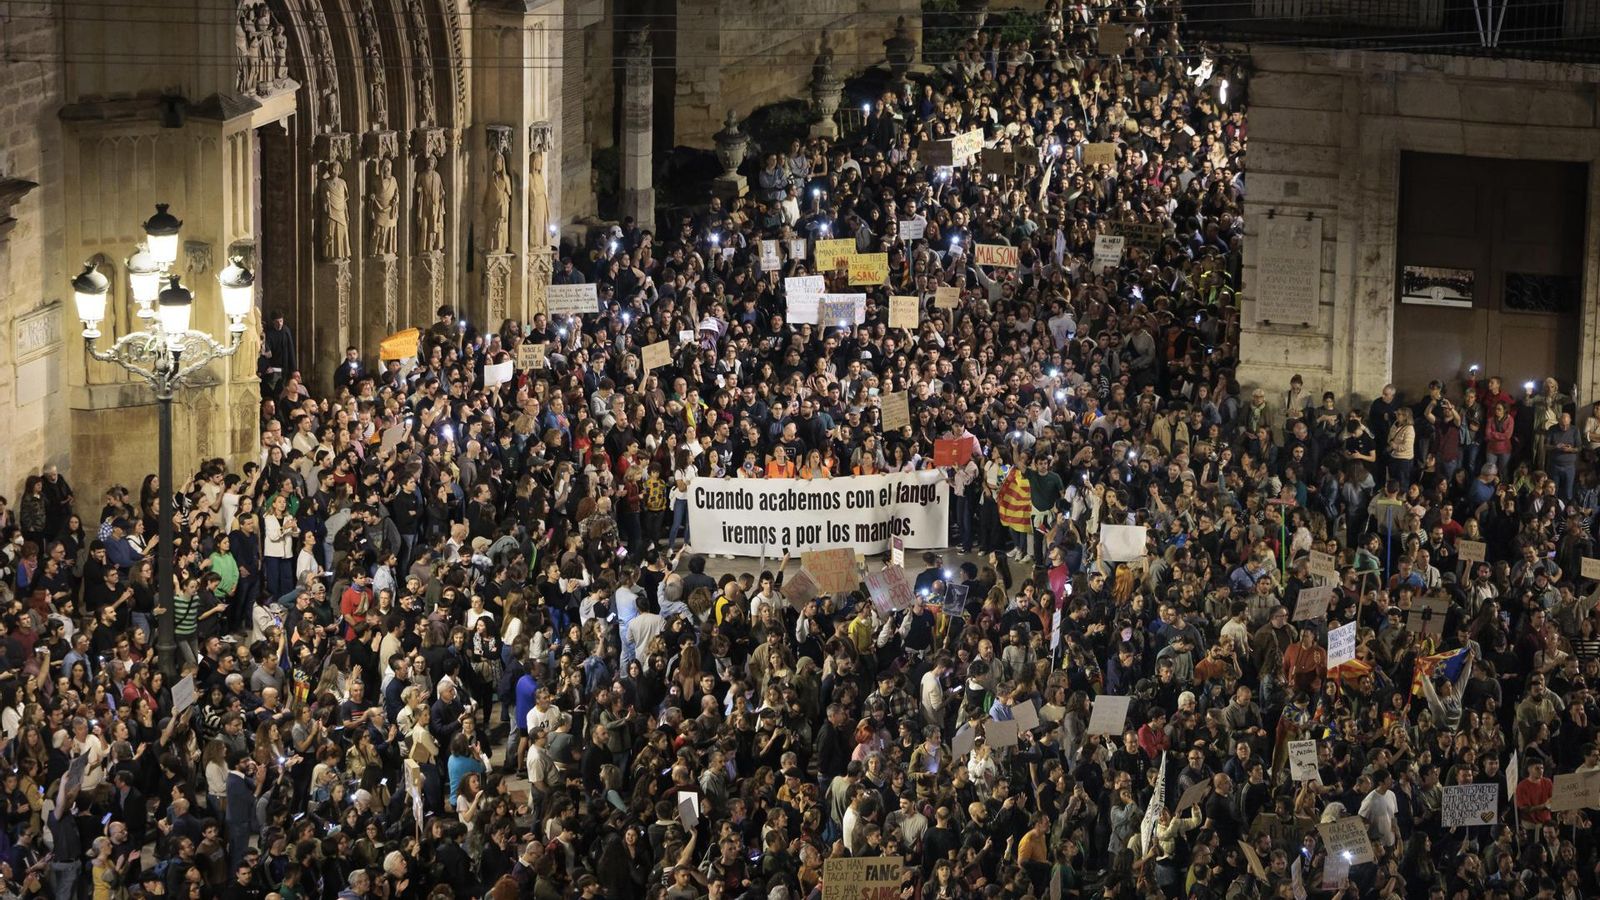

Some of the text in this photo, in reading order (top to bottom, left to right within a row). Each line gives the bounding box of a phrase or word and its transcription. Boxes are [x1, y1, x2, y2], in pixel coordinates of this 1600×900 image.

[832, 256, 849, 267] FAN
[856, 271, 881, 281] SANG
[695, 481, 940, 511] Cuando acabemos con el fango,
[722, 515, 914, 548] iremos a por los mandos.
[826, 859, 864, 871] ENS HAN
[827, 864, 900, 882] TACAT DE FANG
[825, 884, 858, 895] ELS HAN
[861, 886, 901, 900] SANG
